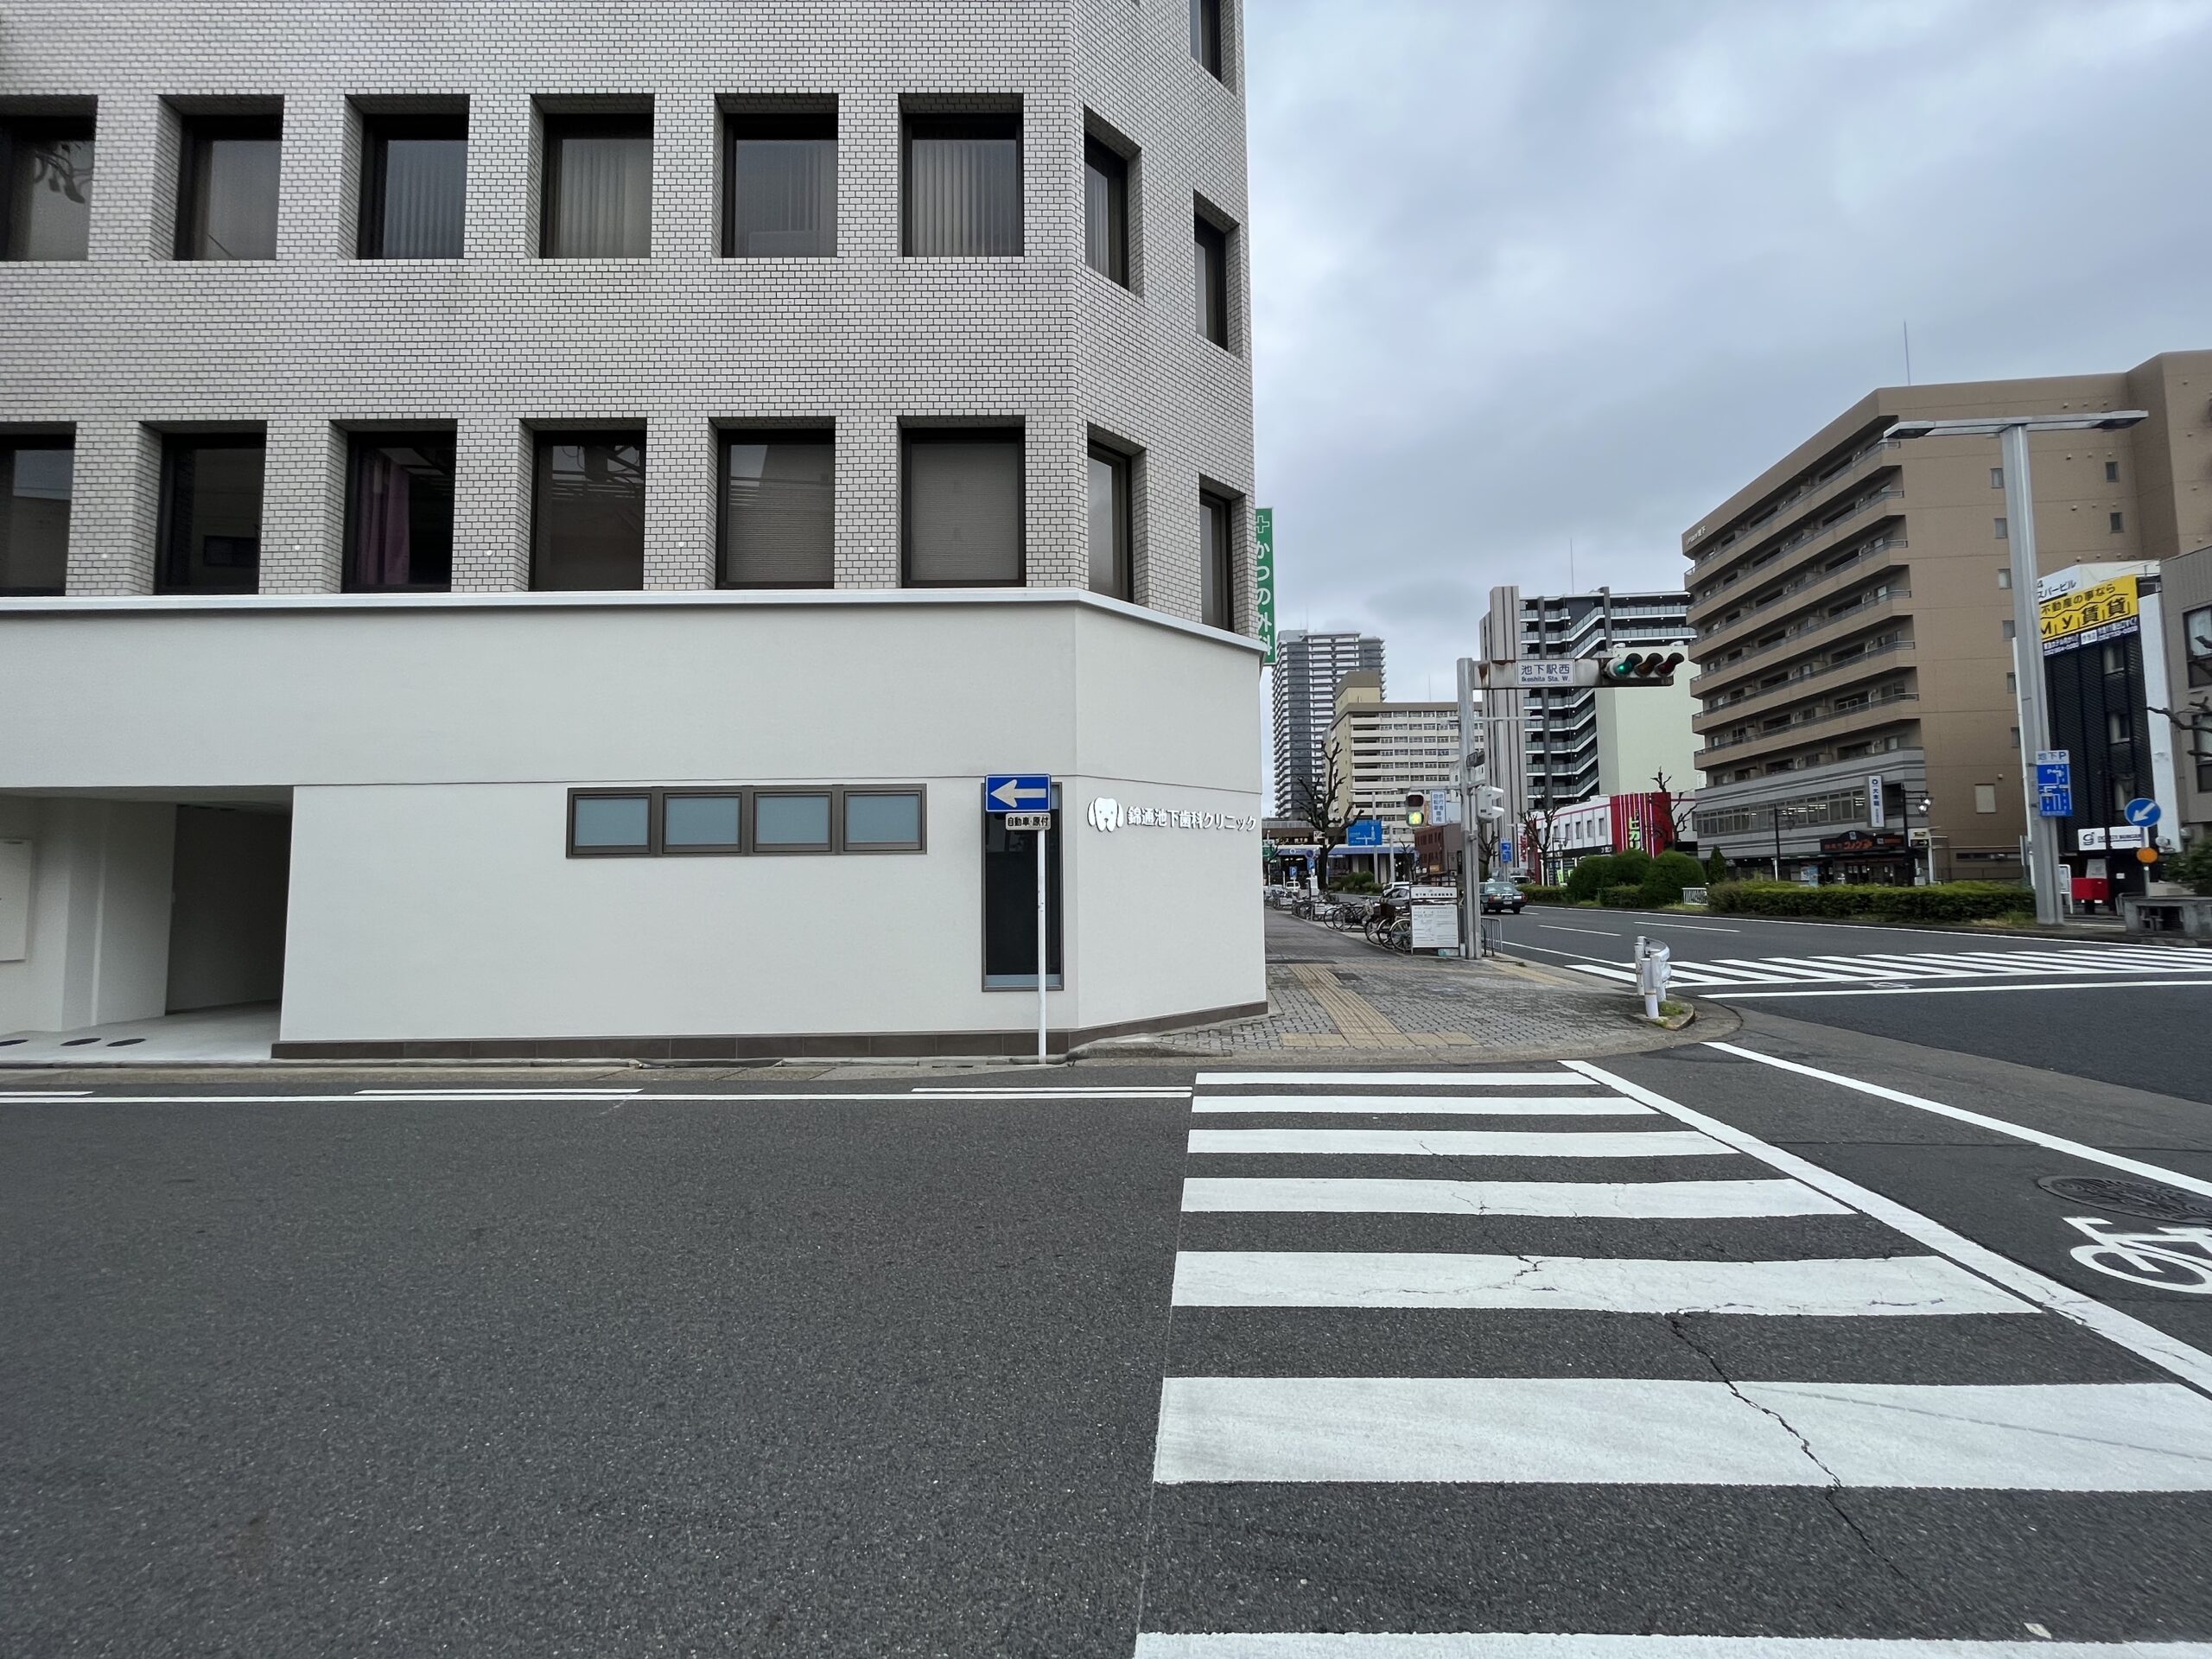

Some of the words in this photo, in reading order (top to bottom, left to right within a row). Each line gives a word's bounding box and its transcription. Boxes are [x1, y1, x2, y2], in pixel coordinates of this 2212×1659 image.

[2041, 583, 2115, 615] 不動産の事なら
[1521, 664, 1570, 675] 池下駅西
[1007, 817, 1048, 827] 自動車・原付
[1127, 806, 1256, 831] 錦通池下歯科クリニック
